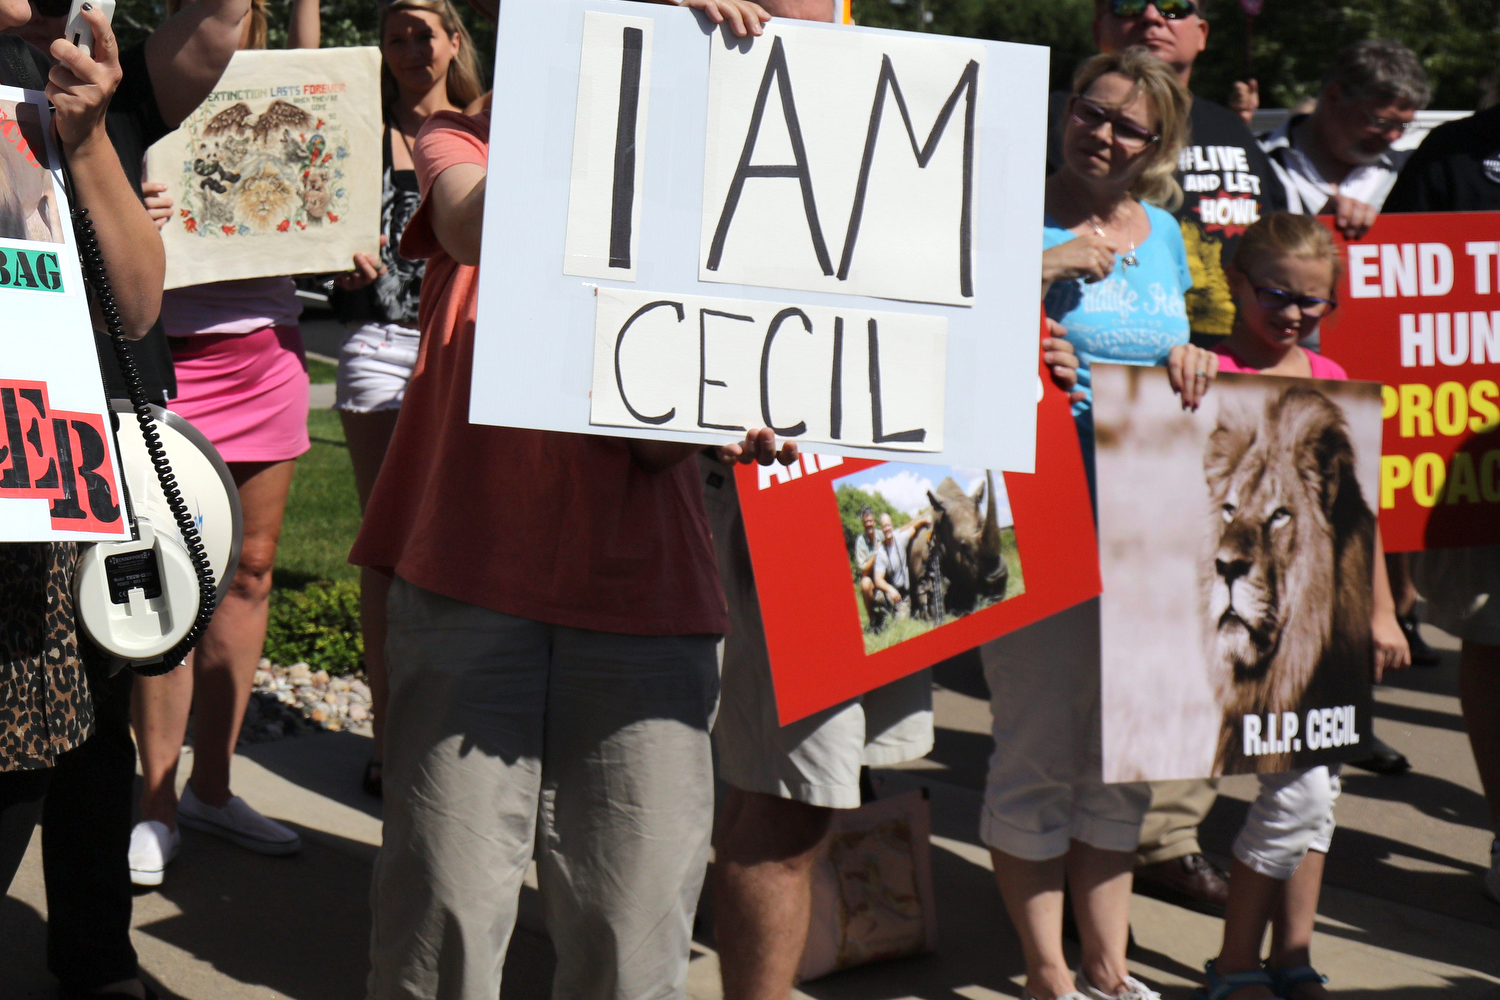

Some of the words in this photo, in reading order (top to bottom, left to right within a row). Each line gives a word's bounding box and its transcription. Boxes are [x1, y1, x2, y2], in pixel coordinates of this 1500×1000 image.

[270, 86, 301, 98] LASTS
[304, 83, 346, 94] FOREVER
[608, 26, 644, 269] I
[706, 35, 980, 298] AM
[1179, 145, 1250, 172] #LIVE
[1184, 174, 1221, 192] AND
[1223, 171, 1261, 195] LET
[1199, 197, 1261, 225] HOWL
[1348, 242, 1455, 298] END
[1400, 310, 1500, 367] HUN
[614, 300, 927, 444] CECIL
[1243, 711, 1301, 756] R.I.P.
[1306, 705, 1360, 751] CECIL
